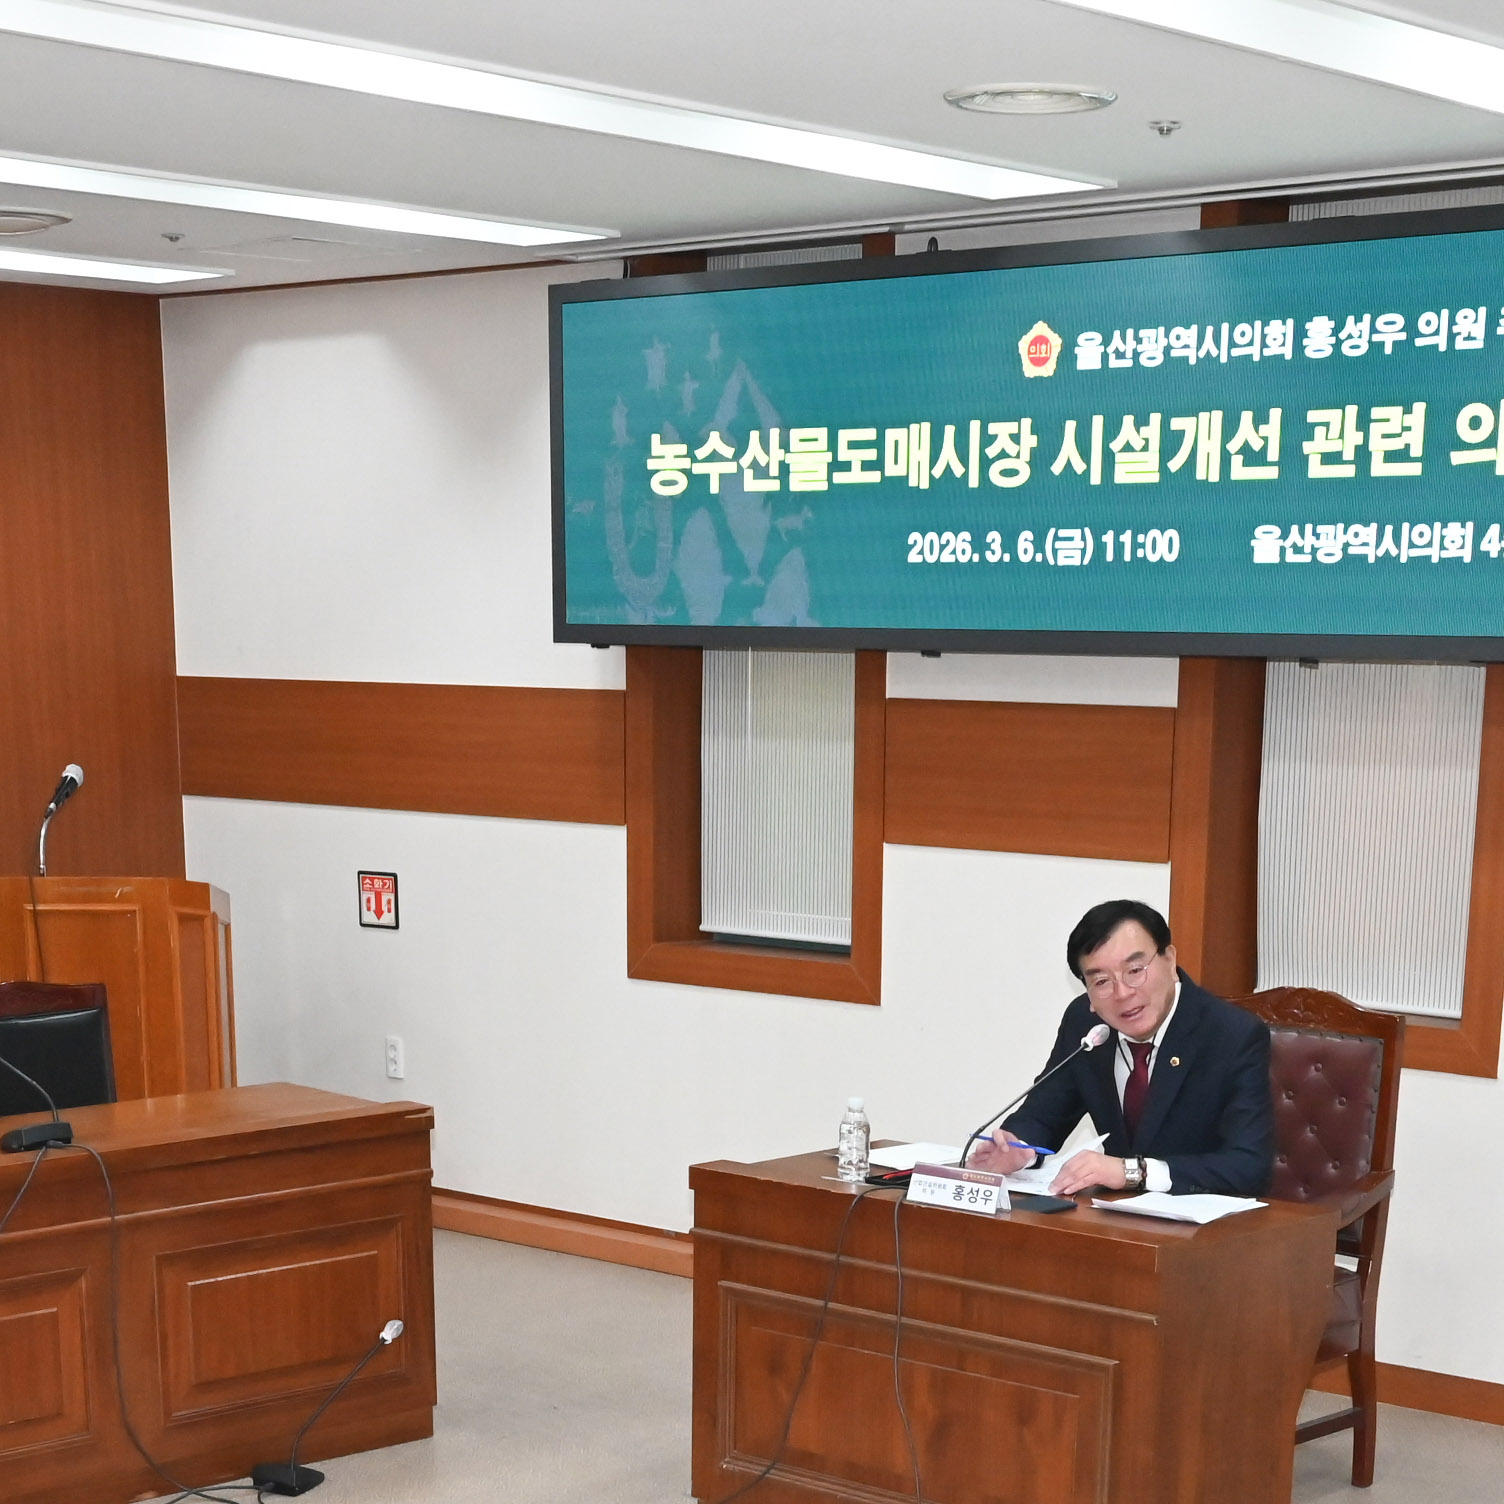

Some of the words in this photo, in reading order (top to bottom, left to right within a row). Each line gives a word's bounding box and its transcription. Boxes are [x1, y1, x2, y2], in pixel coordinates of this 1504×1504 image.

[1074, 318, 1294, 370] 울산광역시의회
[1302, 313, 1407, 359] 홍성우
[1414, 306, 1487, 352] 의원
[646, 416, 1037, 496] 농수산물도매시장
[1049, 407, 1283, 486] 시설개선
[1301, 400, 1427, 479] 관련
[907, 531, 980, 563] 2026.
[985, 530, 1011, 563] 3.
[1101, 528, 1180, 563] 11:00
[1250, 521, 1474, 564] 울산광역시의회
[363, 877, 393, 890] 소화기
[952, 1184, 993, 1206] 홍성우
